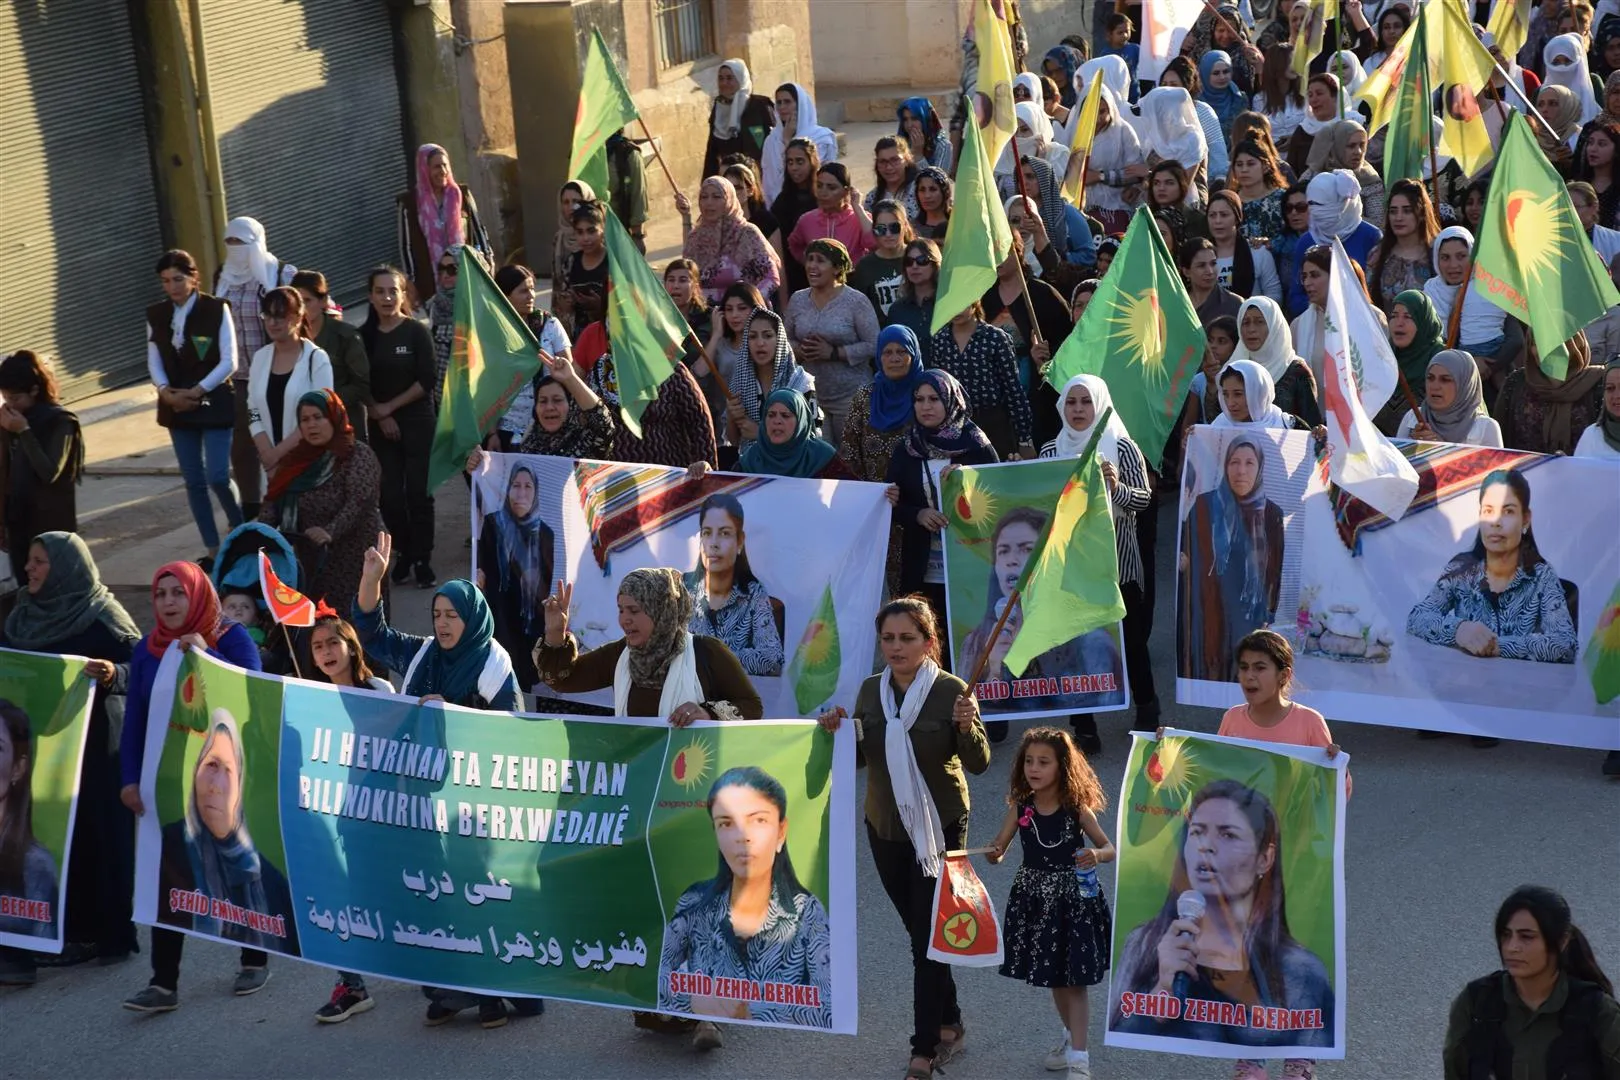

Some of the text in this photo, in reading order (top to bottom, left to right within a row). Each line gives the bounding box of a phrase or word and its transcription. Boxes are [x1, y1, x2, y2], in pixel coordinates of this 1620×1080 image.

[974, 672, 1117, 701] EHÎD ZEHRA BERKEL
[311, 727, 628, 797] JI HEVRÎNAN TA ZEHREYAN
[298, 775, 629, 846] BILINDKIRINA BERXWEDANÊ
[402, 868, 512, 905] على درب
[0, 895, 51, 923] BERKEL
[307, 896, 648, 972] هفرين وزهرا سنصعد المقاومة
[715, 976, 761, 1001] ZEHRA
[764, 982, 821, 1007] BERKEL
[1121, 990, 1324, 1031] ŞEHÎD ZEHRA BERKEL
